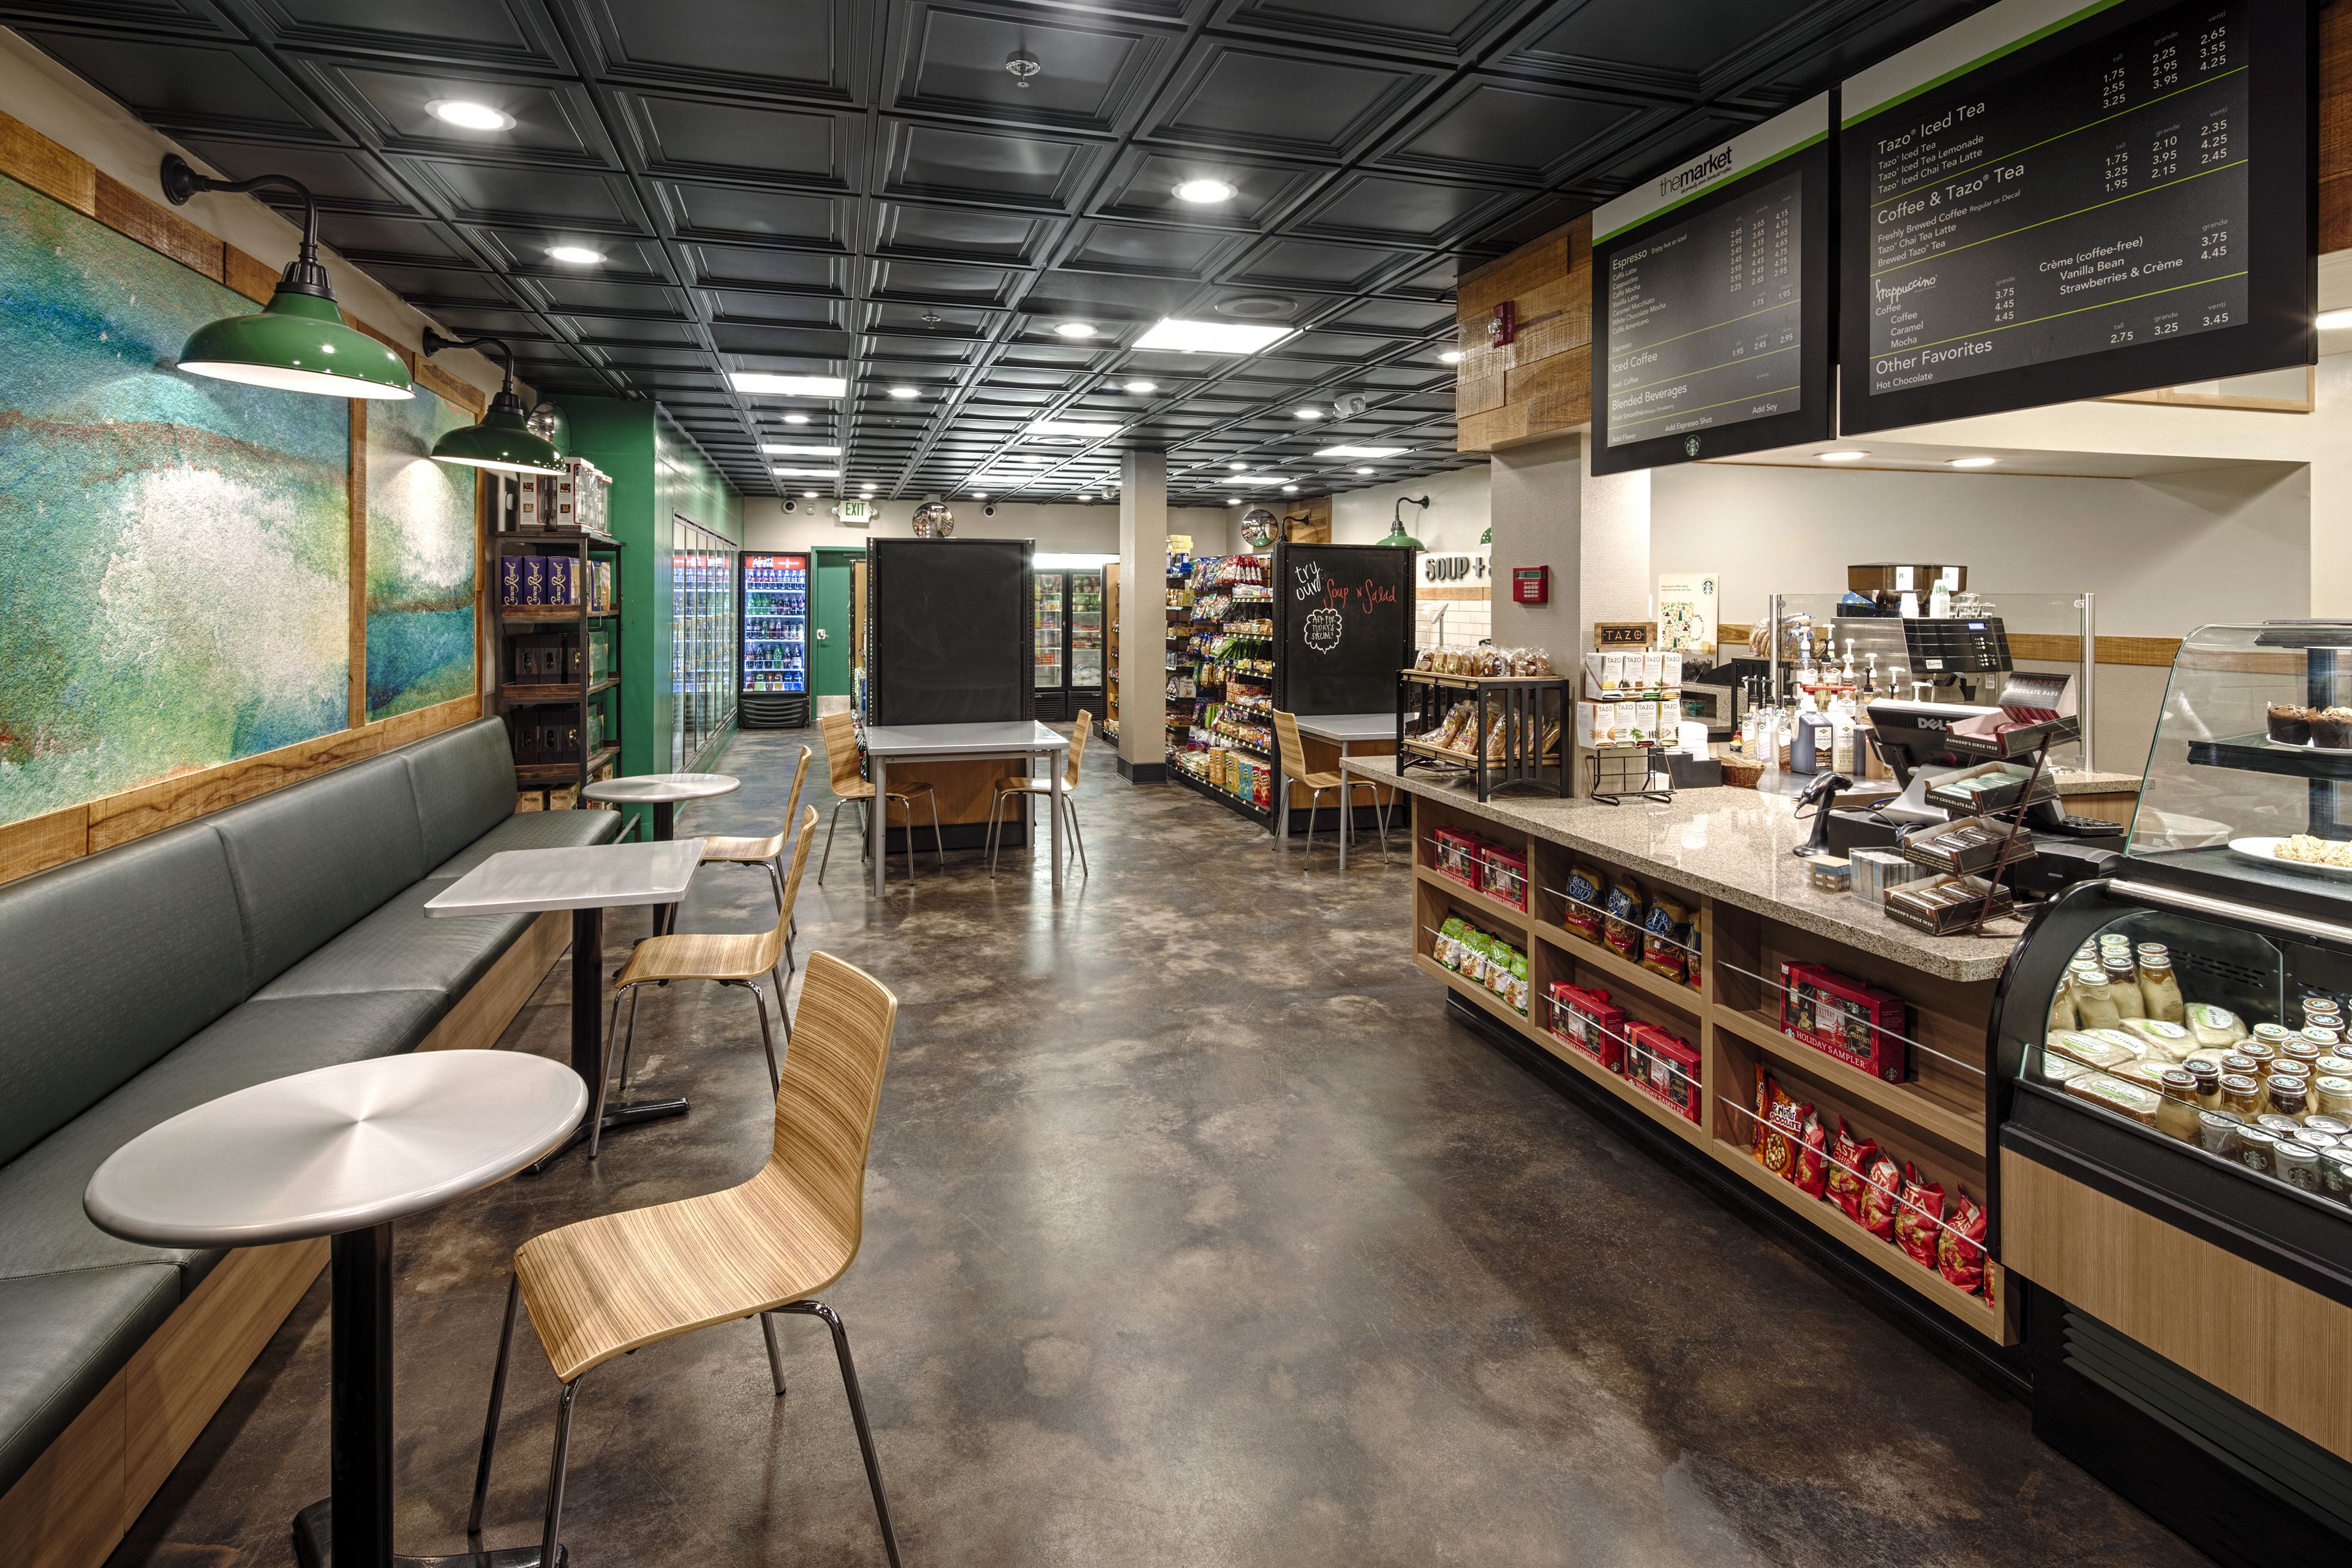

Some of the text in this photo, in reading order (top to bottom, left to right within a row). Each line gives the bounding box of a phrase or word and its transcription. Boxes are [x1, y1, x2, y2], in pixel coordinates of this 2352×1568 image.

[2103, 27, 2226, 83] 1.75 2.25 2.65
[2103, 41, 2226, 96] 2.55 2.95 3.55
[2103, 55, 2226, 108] 3.25 3.95 4.25
[1921, 111, 1951, 137] Iced
[1956, 102, 1985, 121] Tea
[1901, 147, 1918, 160] Iced
[1921, 141, 1936, 154] Tea
[2106, 120, 2227, 166] 1.75 2.10 2.35
[1901, 159, 1918, 173] Iced
[1921, 153, 1936, 167] Tea
[1938, 135, 1984, 159] Lemonade
[2105, 134, 2227, 179] 3.25 3.95 4.25
[1901, 172, 1918, 185] Iced
[1921, 165, 1939, 178] Chai
[1941, 159, 1958, 171] Tea
[1959, 148, 1983, 164] Latte
[2105, 148, 2227, 192] 1.95 2.15 2.45
[1878, 200, 1924, 224] Coffee
[1930, 192, 1941, 206] &
[1994, 165, 2024, 183] Tea
[1878, 228, 1904, 243] Freshly
[1906, 216, 1937, 233] Brewed
[1939, 208, 1967, 222] Coffee
[1970, 200, 1992, 213] Regular
[2002, 189, 2021, 202] Decaf
[1899, 236, 1917, 247] Chai
[1918, 233, 1932, 241] Tea
[1935, 224, 1956, 236] Latte
[2201, 232, 2227, 246] 3.75
[1613, 250, 1647, 270] Espresso
[1678, 233, 1687, 243] iced
[1878, 251, 1906, 266] Brewed
[1931, 240, 1945, 250] Tea
[2040, 236, 2143, 272] Crème (coffee-free)
[2201, 246, 2227, 260] 4.45
[2060, 258, 2125, 281] Vanilla Bean
[2060, 258, 2183, 295] Strawberries & Crème
[1613, 276, 1638, 290] Cappuccino
[1626, 284, 1640, 295] Mocha
[1613, 299, 1627, 307] Vanilla
[1996, 288, 2014, 299] 3.75
[1613, 298, 1655, 317] Caramel Macchiato
[1626, 309, 1649, 321] Chocolate
[1650, 303, 1666, 313] Mocha
[1875, 304, 1901, 316] Coffee
[1995, 300, 2014, 310] 4.45
[1625, 318, 1649, 330] Americano
[1891, 312, 1917, 324] Coffee
[1995, 312, 2014, 322] 4.45
[1891, 321, 1923, 336] Caramel
[2111, 313, 2229, 344] 2.75 3.25 3.45
[1613, 343, 1632, 353] Espresso
[1891, 337, 1917, 348] Mocha
[1612, 352, 1658, 373] Iced Coffee
[1876, 341, 1992, 374] Other Favorites
[1624, 376, 1638, 386] Coffee
[1877, 372, 1933, 390] Hot Chocolate
[1612, 385, 1687, 410] Blended Beverages
[1623, 410, 1644, 419] Smoothie
[1752, 403, 1777, 415] Add Soy
[1677, 421, 1699, 430] Espresso
[846, 502, 865, 516] EXIT
[504, 562, 519, 592] Royal
[528, 562, 543, 592] Royal
[551, 562, 565, 592] Royal
[1425, 557, 1469, 580] SOUP
[1296, 582, 1321, 600] our
[1324, 578, 1349, 609] Soup
[1362, 579, 1396, 613] Salad
[1325, 615, 1336, 626] FOR
[1606, 630, 1642, 639] TAZO
[1918, 717, 1951, 731] DEL
[1946, 737, 1972, 746] HAMMOND'S
[1940, 797, 1964, 808] CHOCOLATE
[1569, 884, 1591, 899] GOLD
[1573, 876, 1592, 891] ROLD
[1886, 905, 1933, 928] HAMMOND'S SINCE 1920
[1796, 1031, 1827, 1050] HOLIDAY
[1828, 1046, 1865, 1068] SAMPLER
[1636, 1082, 1684, 1115] HOLIDAY SAMPLER
[1833, 1152, 1852, 1167] CHIPS
